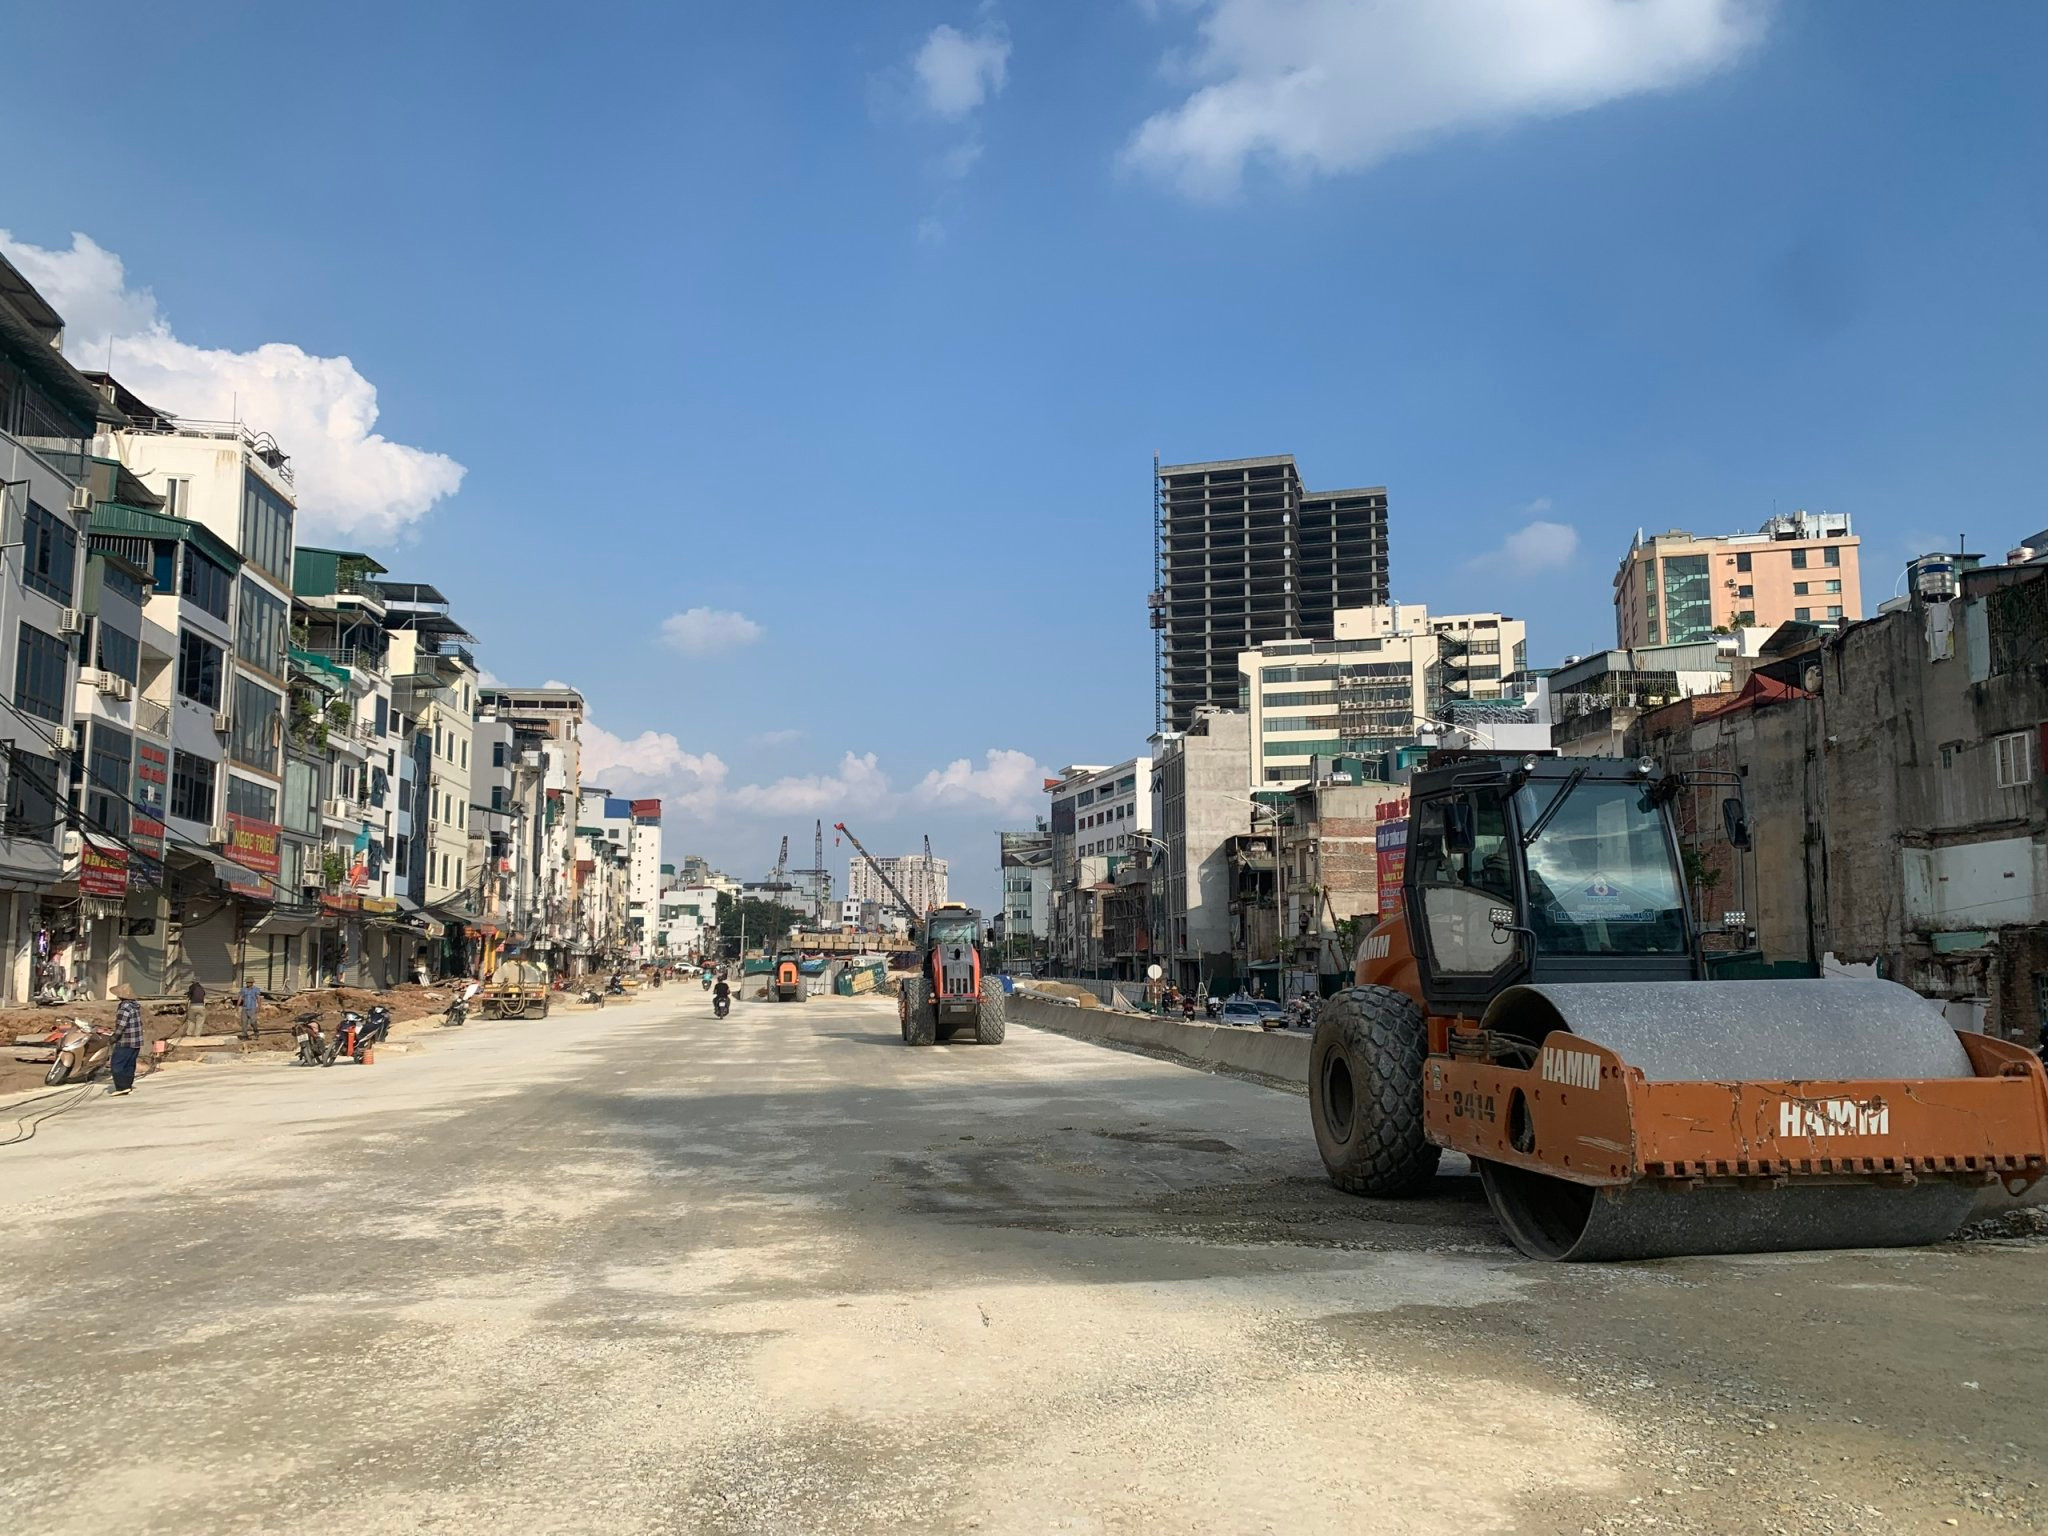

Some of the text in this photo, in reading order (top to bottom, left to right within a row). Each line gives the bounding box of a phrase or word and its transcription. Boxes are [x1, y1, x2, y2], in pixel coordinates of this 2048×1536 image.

[1542, 1046, 1601, 1091] HAMM
[1453, 1090, 1496, 1124] 3414
[1780, 1101, 1888, 1137] HAMM
